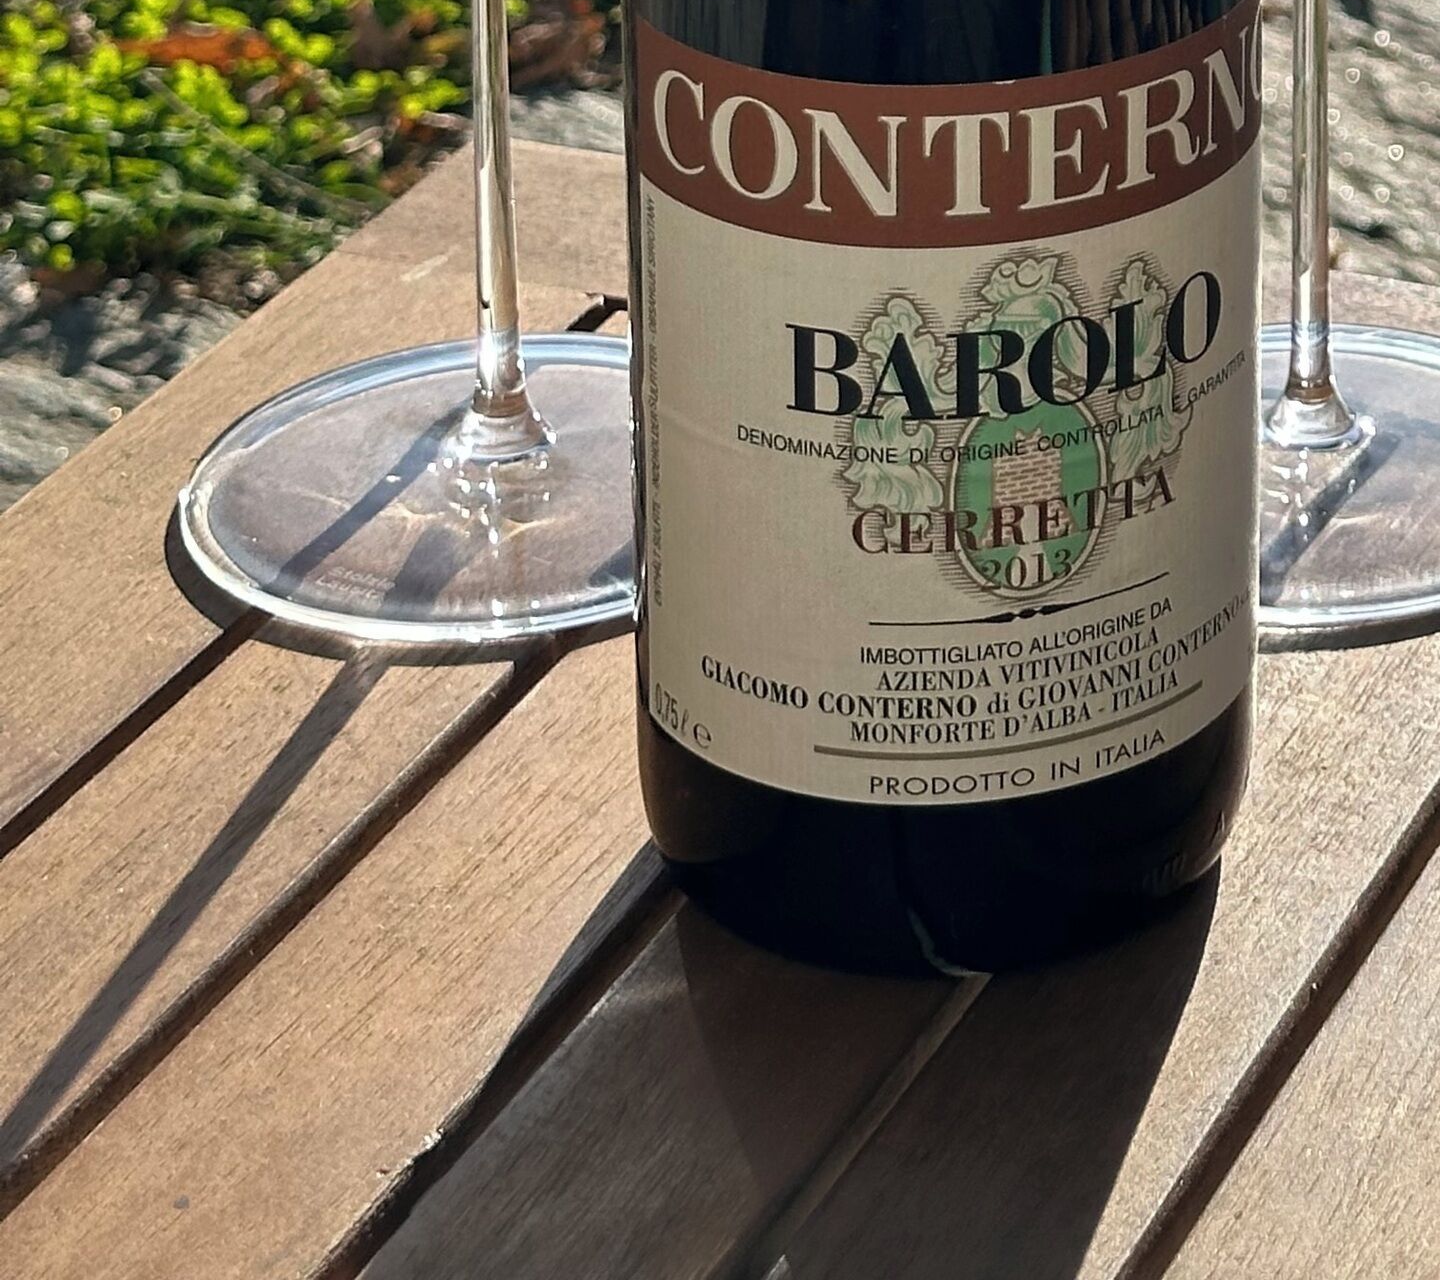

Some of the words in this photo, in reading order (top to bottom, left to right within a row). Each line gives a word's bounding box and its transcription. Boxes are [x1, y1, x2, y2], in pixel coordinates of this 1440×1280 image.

[785, 271, 1222, 420] BAROLO
[738, 424, 899, 463] DENOMINAZIONE
[909, 447, 929, 464] DI
[940, 439, 1027, 463] ORIGINE
[1037, 404, 1164, 451] CONTROLLATA
[852, 466, 1176, 554] CERRETTA
[979, 548, 1072, 591] 2013
[701, 655, 808, 709] GIACOMO
[818, 691, 977, 719] CONTERNO
[987, 693, 1009, 715] di
[1018, 658, 1141, 710] GIOVANNI
[1147, 594, 1240, 674] CONTERNO
[861, 639, 1023, 665] IMBOTTIGLIATO
[1029, 608, 1146, 656] ALL'ORIGINE
[1150, 597, 1173, 620] DA
[876, 669, 991, 691] AZIENDA
[999, 626, 1159, 685] VITIVINICOLA
[850, 719, 995, 744] MONFORTE
[1004, 704, 1092, 737] D'ALBA
[1111, 670, 1179, 713] ITALIA
[869, 768, 1035, 796] PRODOTTO
[1051, 756, 1080, 780] IN
[1095, 728, 1167, 769] ITALIA
